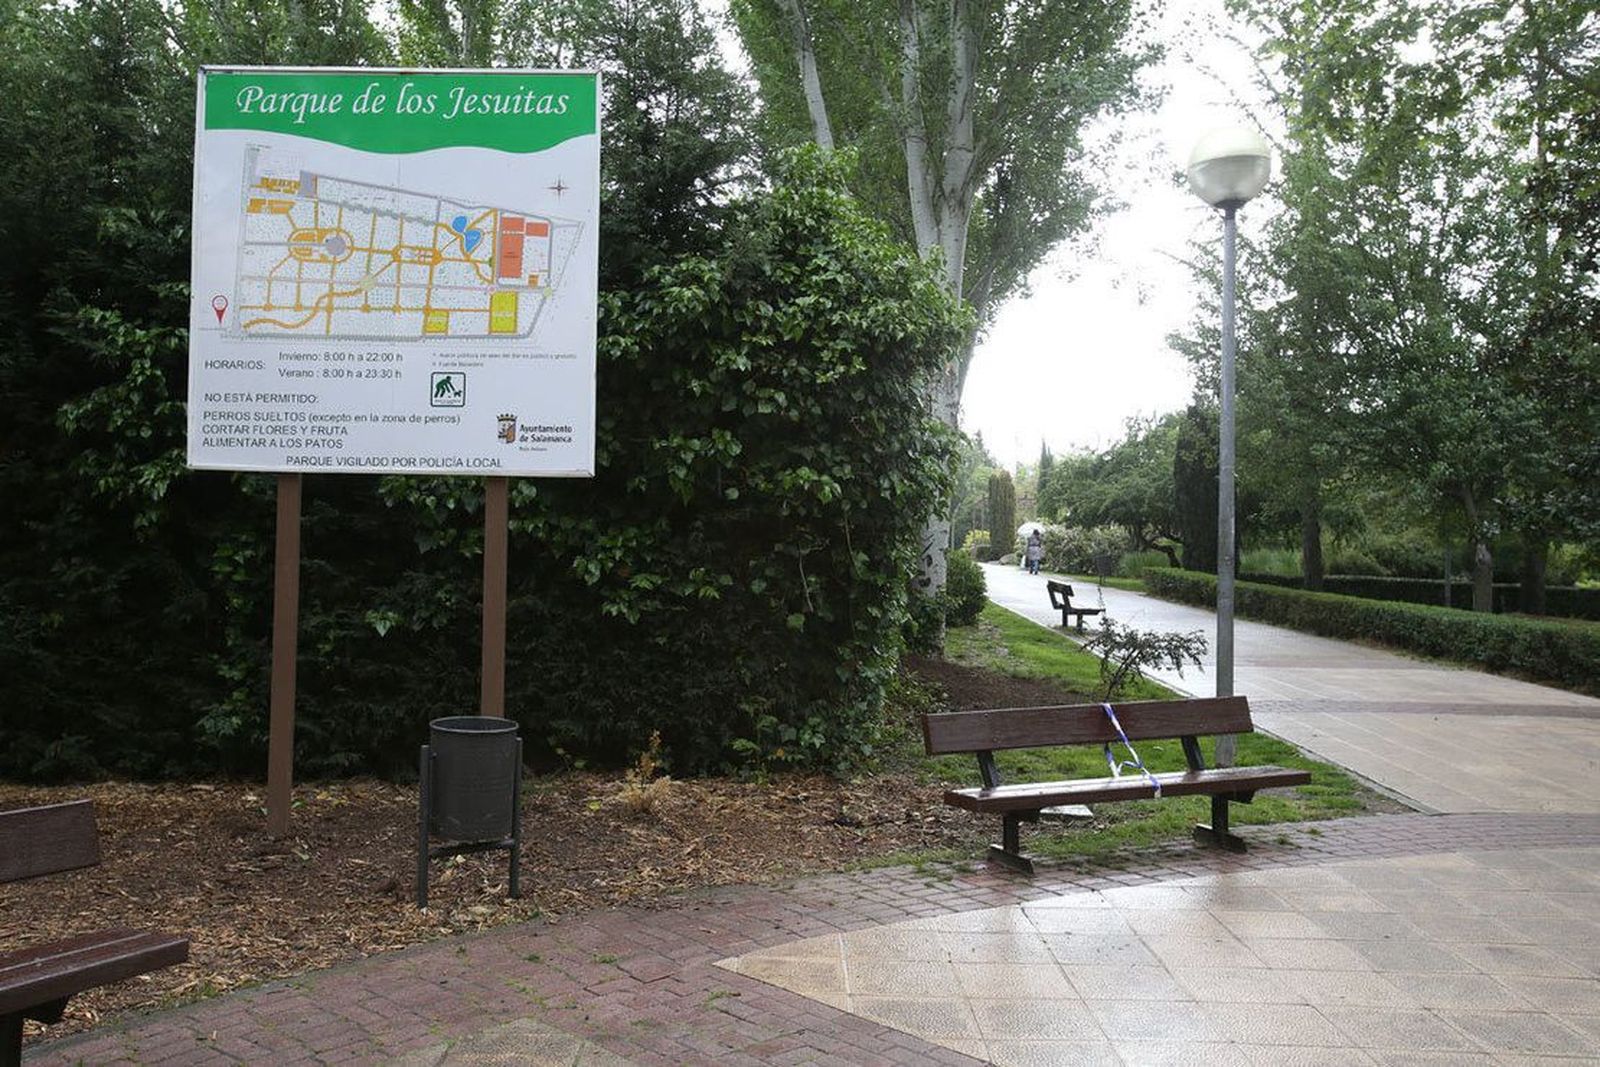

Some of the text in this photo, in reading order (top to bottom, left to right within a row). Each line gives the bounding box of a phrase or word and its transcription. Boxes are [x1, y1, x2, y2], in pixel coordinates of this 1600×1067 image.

[236, 83, 569, 124] Parque de los Jesuitas
[279, 352, 321, 362] Invierno:
[348, 353, 354, 362] h
[395, 354, 403, 362] h
[278, 368, 315, 378] Verano
[347, 370, 354, 379] h
[355, 371, 362, 379] a
[395, 370, 402, 379] h
[204, 392, 222, 402] NO
[203, 411, 461, 426] PERROS SUELTOS (excepto en la zona de perros)
[202, 425, 348, 436] CORTAR FLORES Y FRUTA
[520, 424, 572, 434] Ayuntamiento
[202, 438, 344, 449] ALIMENTAR A LOS PATOS
[520, 433, 572, 443] de Salamanca
[286, 456, 333, 467] PARQUE
[336, 456, 389, 467] VIGILADO
[392, 457, 416, 467] POR
[466, 458, 502, 468] LOCAL
